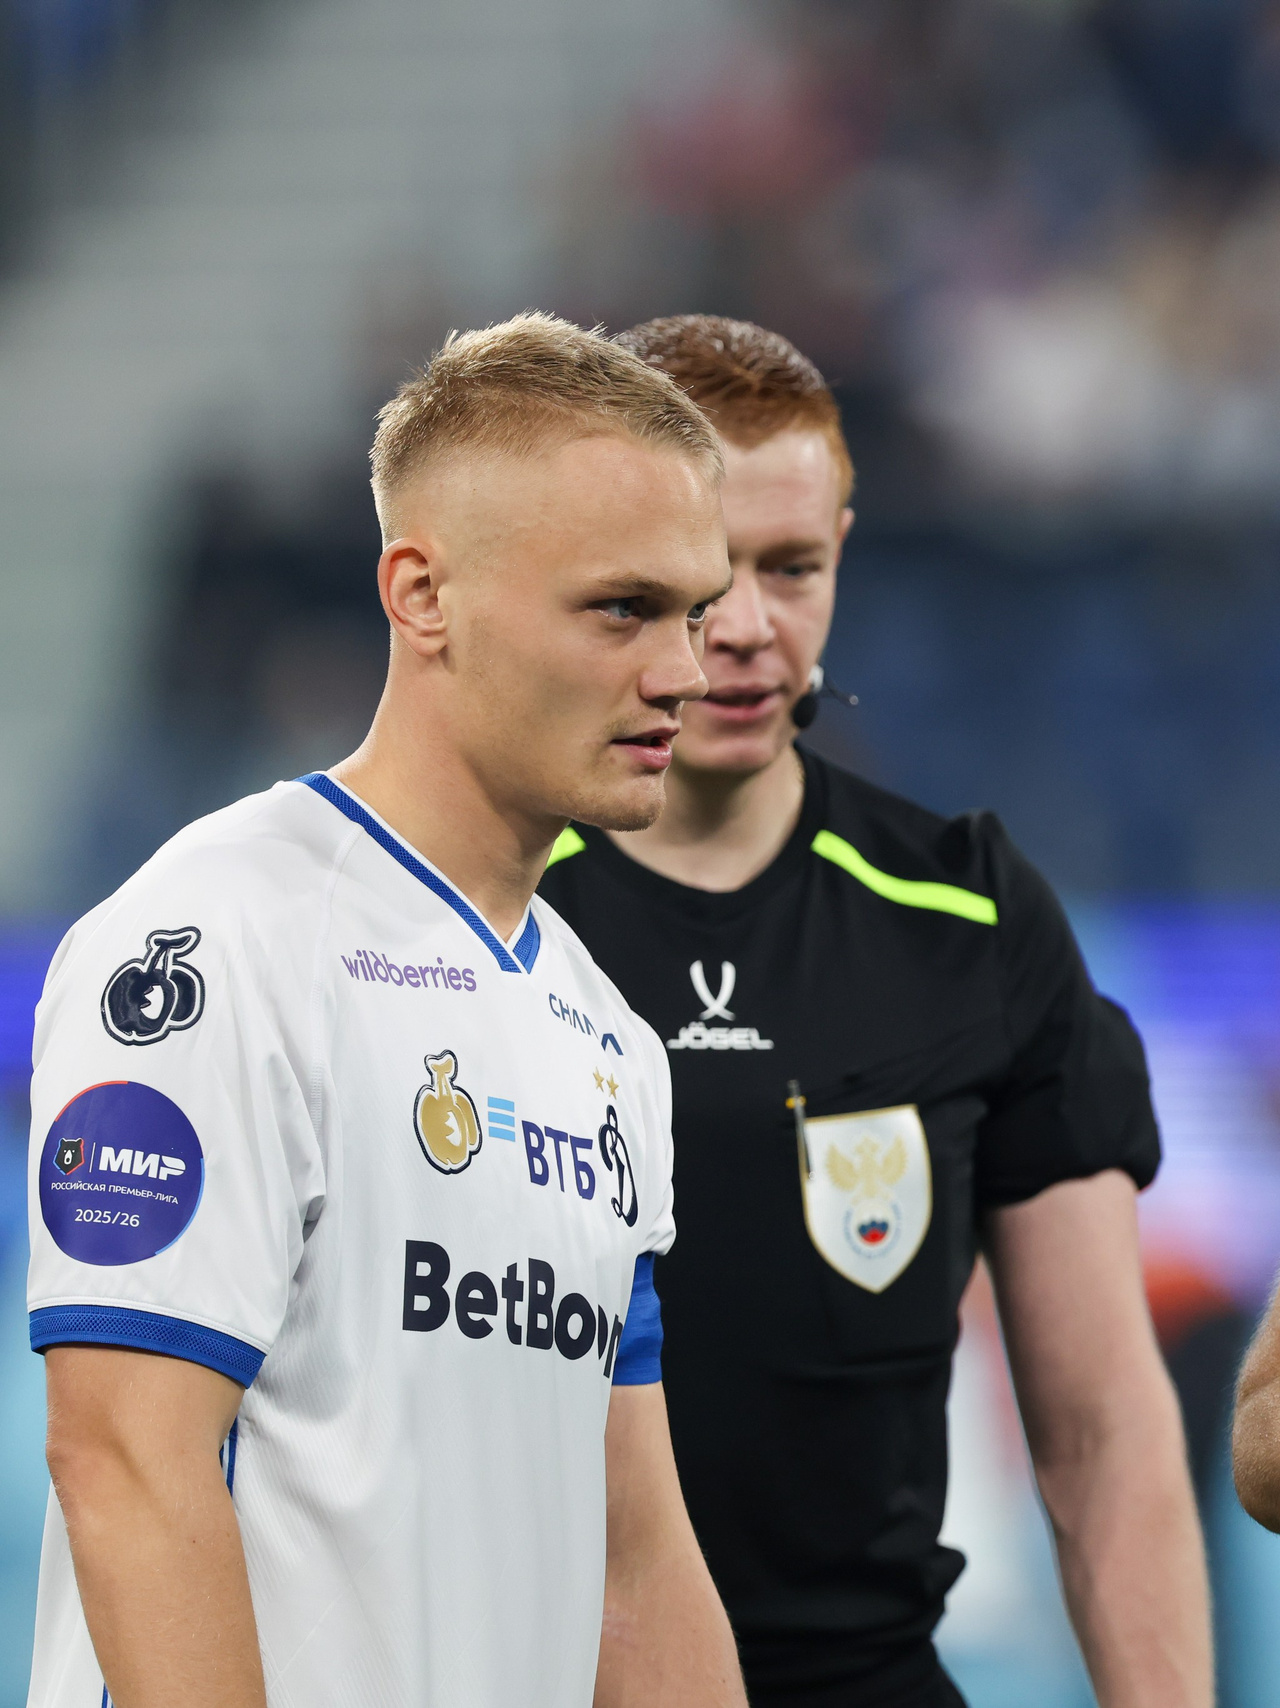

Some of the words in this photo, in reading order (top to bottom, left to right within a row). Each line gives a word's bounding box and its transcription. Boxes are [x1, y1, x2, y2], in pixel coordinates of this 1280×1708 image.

[341, 949, 477, 992] wildberries
[98, 1146, 187, 1181] МИР
[521, 1120, 596, 1201] ВТБ
[51, 1180, 106, 1192] РОССИЙСКАЯ
[108, 1184, 179, 1205] ПРЕМЬЕР-ЛИГА
[74, 1208, 140, 1228] 2025/26
[402, 1239, 624, 1379] BetBo
